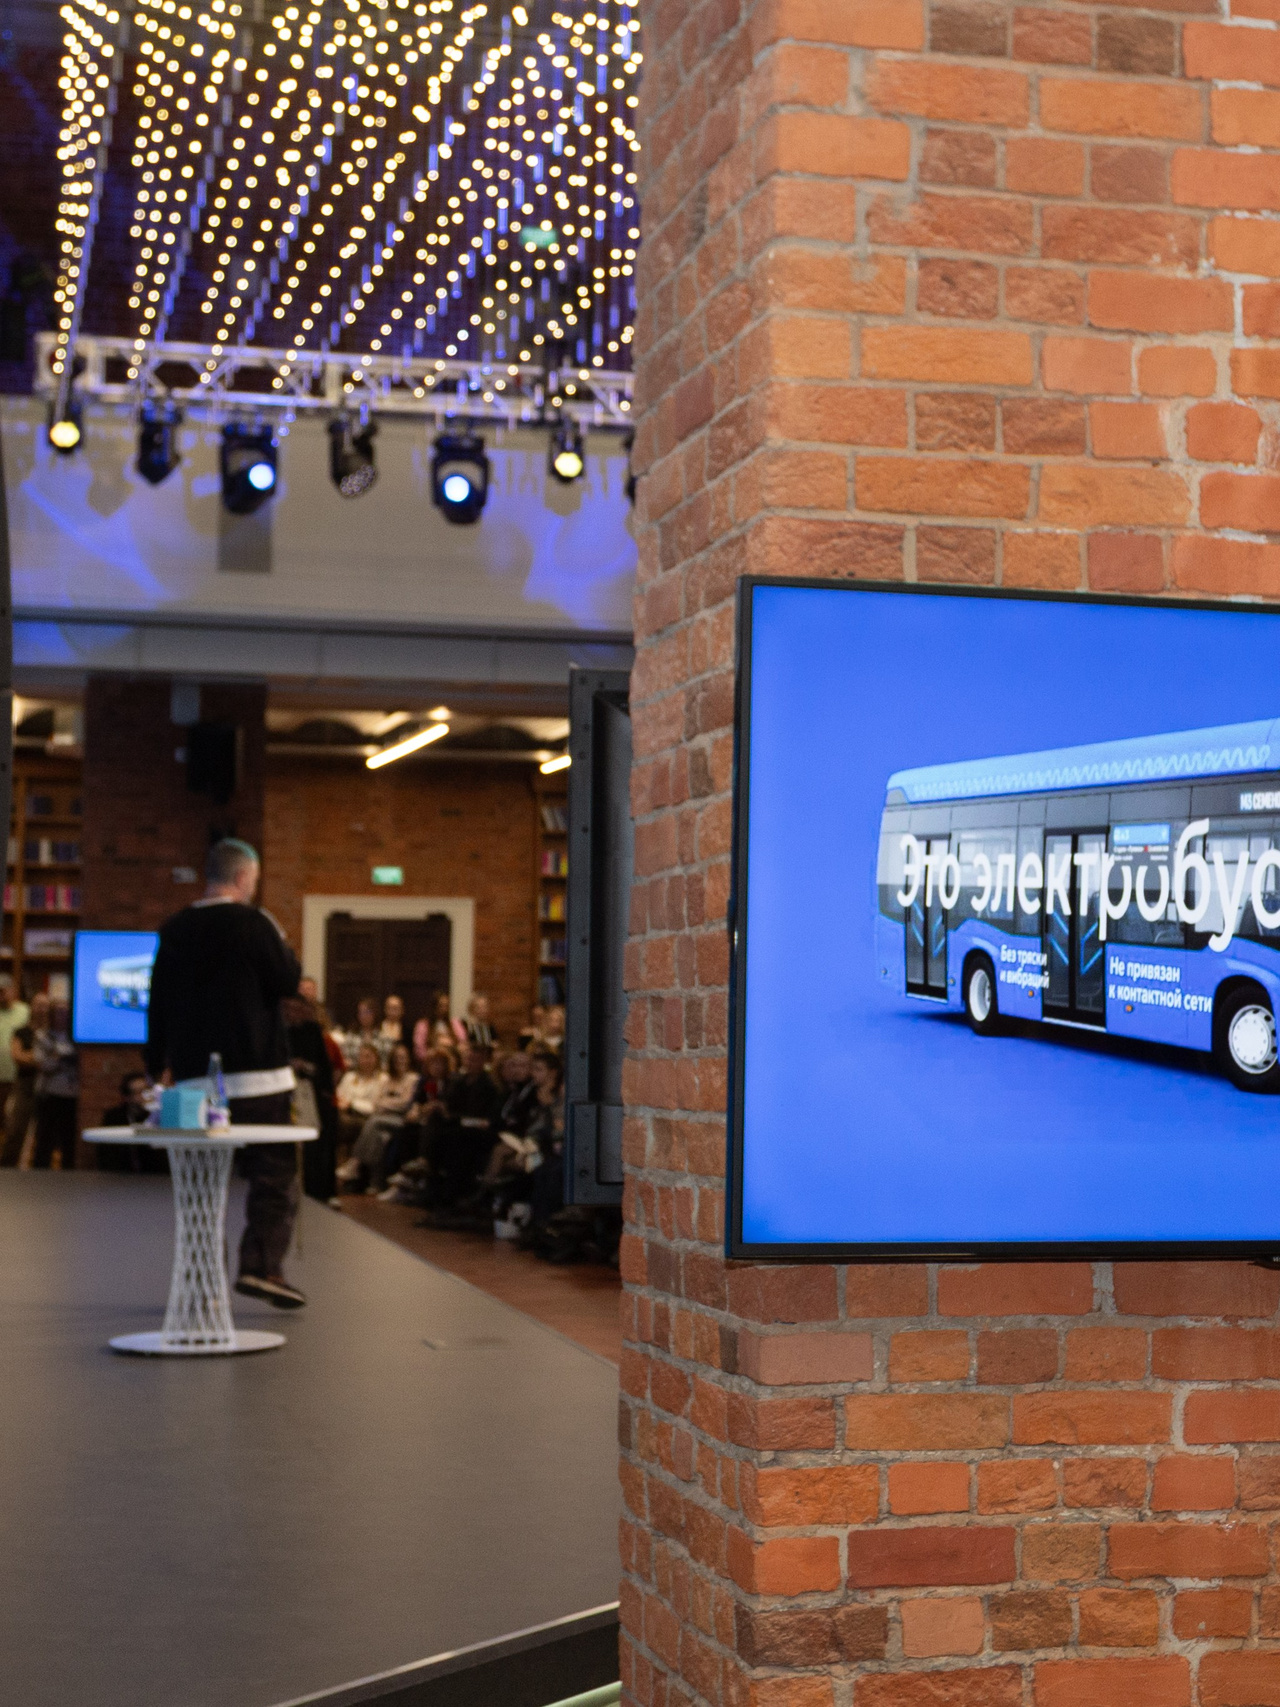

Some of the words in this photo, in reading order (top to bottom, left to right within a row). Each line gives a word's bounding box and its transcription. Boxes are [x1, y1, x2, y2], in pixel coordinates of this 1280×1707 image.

[897, 833, 961, 910] Это
[1001, 944, 1017, 963] Без
[1017, 949, 1048, 968] тряски
[1109, 956, 1126, 977] Не
[1126, 961, 1181, 983] привязан
[1000, 970, 1006, 982] и
[1006, 967, 1050, 989] вибраций
[1108, 984, 1116, 999] к
[1117, 985, 1182, 1009] контактной
[1183, 993, 1213, 1014] сети
